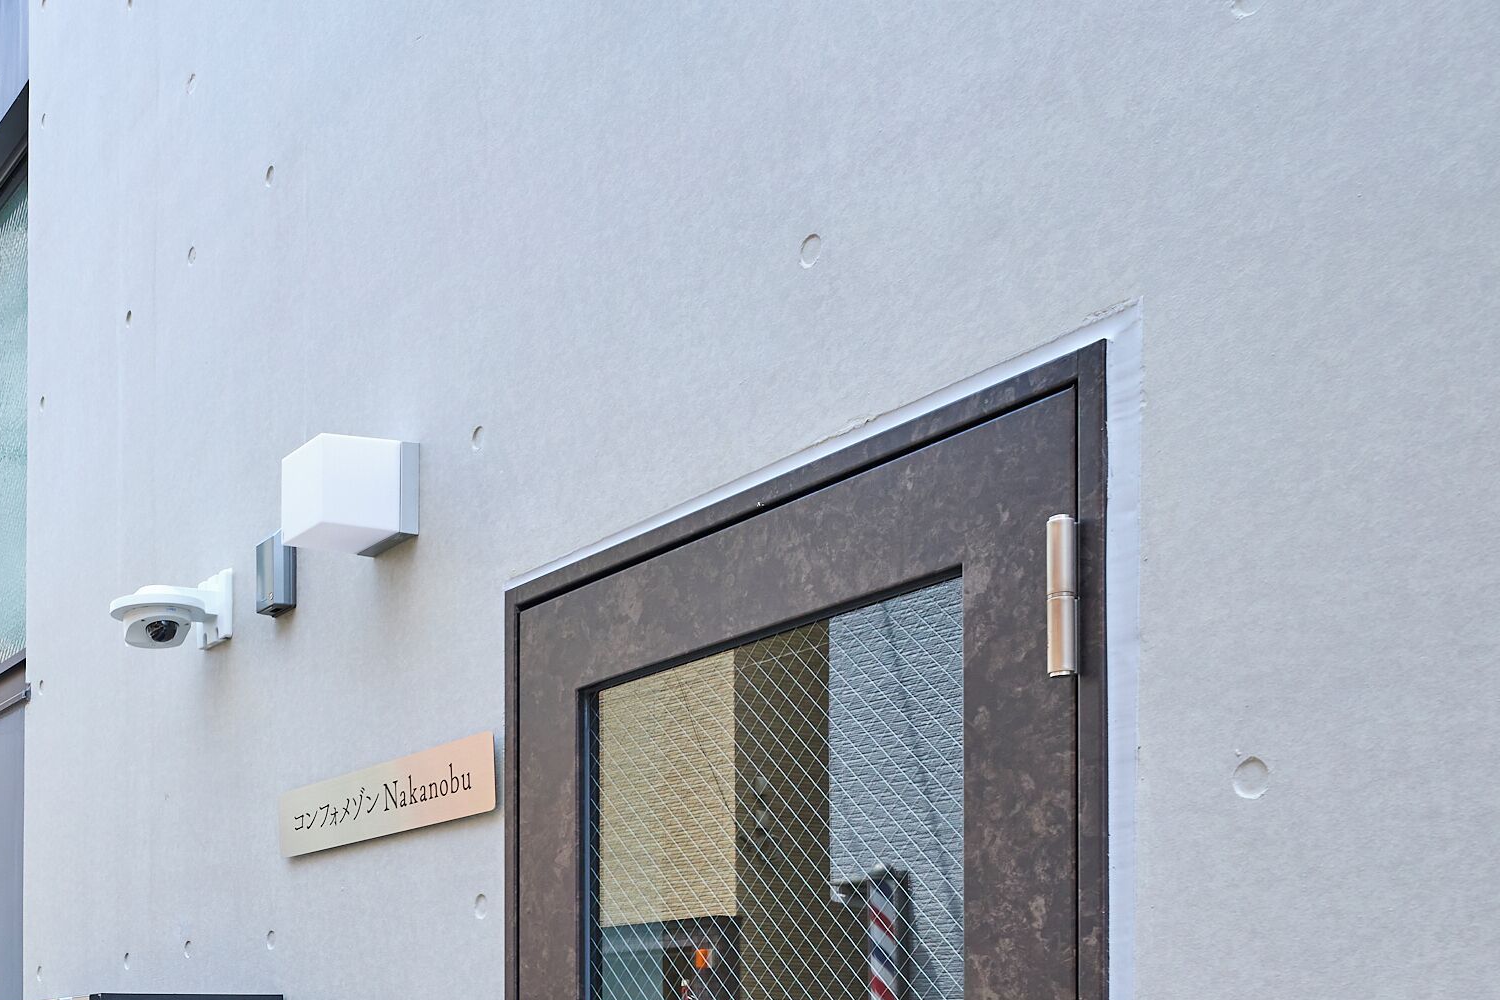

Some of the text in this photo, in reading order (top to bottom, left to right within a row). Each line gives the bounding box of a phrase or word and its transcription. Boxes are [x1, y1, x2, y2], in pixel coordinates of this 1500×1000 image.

[293, 762, 472, 832] コンフォメゾン Nakanobu
